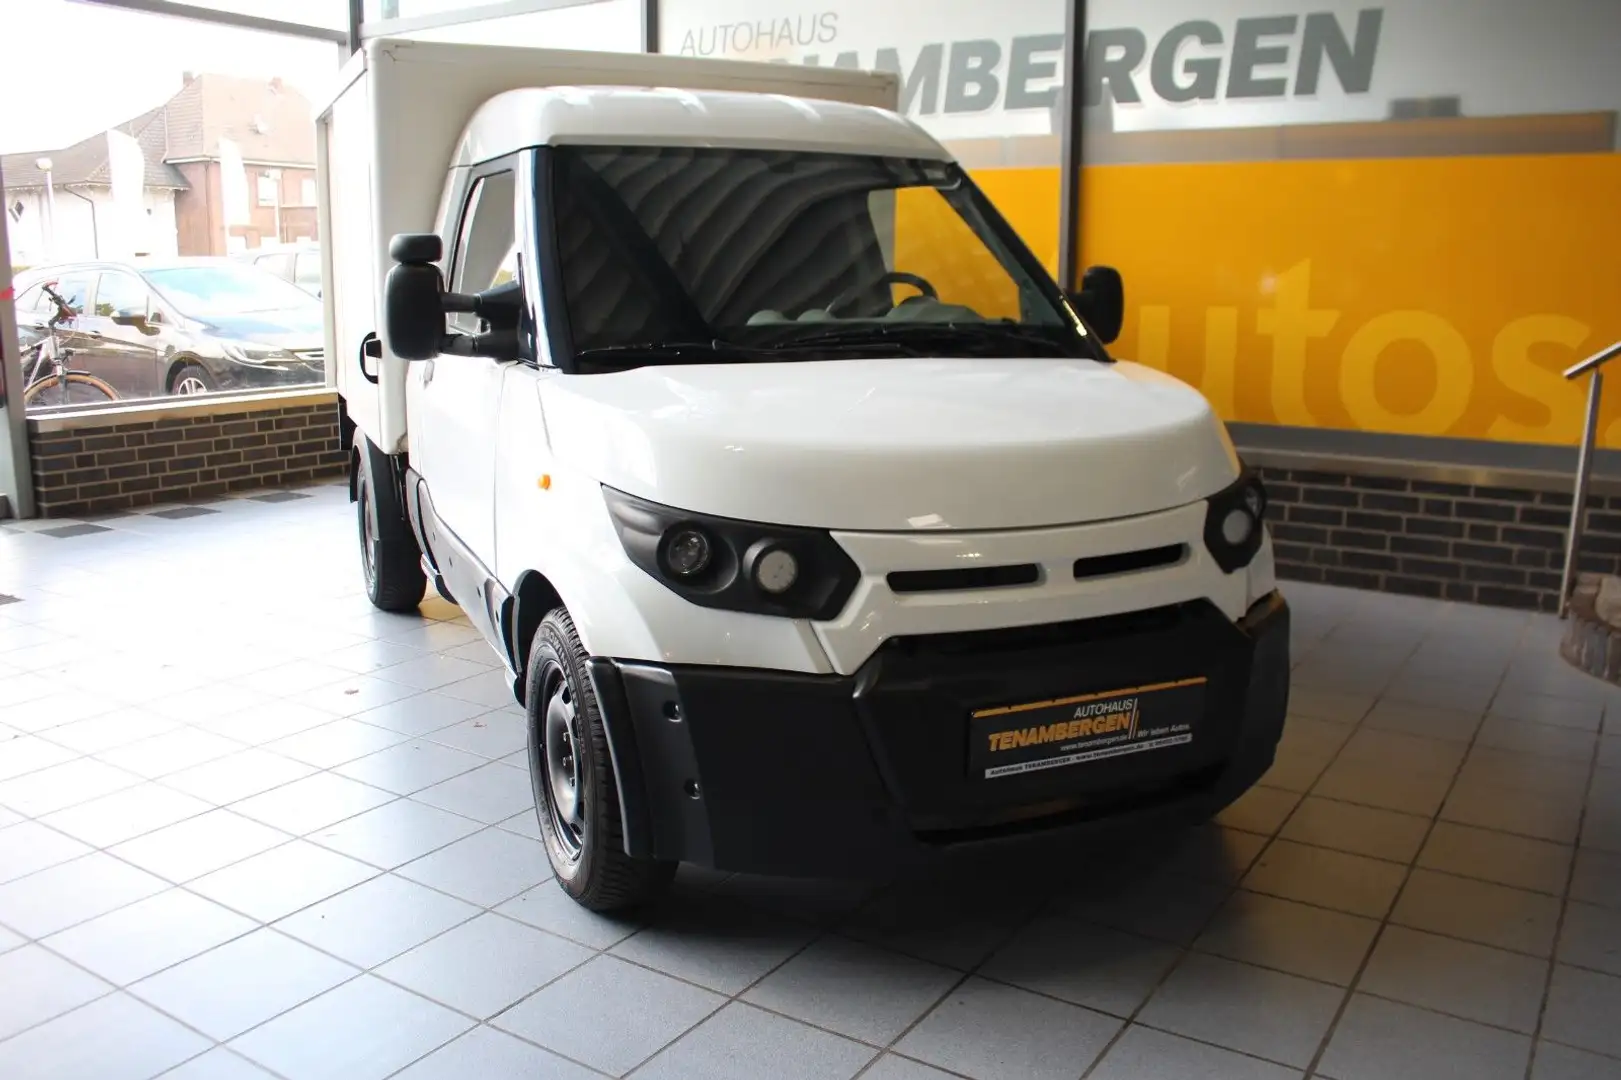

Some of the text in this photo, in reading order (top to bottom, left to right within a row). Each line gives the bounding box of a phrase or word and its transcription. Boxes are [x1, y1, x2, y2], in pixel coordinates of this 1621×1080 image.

[679, 12, 838, 57] AUTOHAUS
[1073, 698, 1133, 719] AUTOHAUS
[988, 711, 1131, 752] TENAMBERGEN
